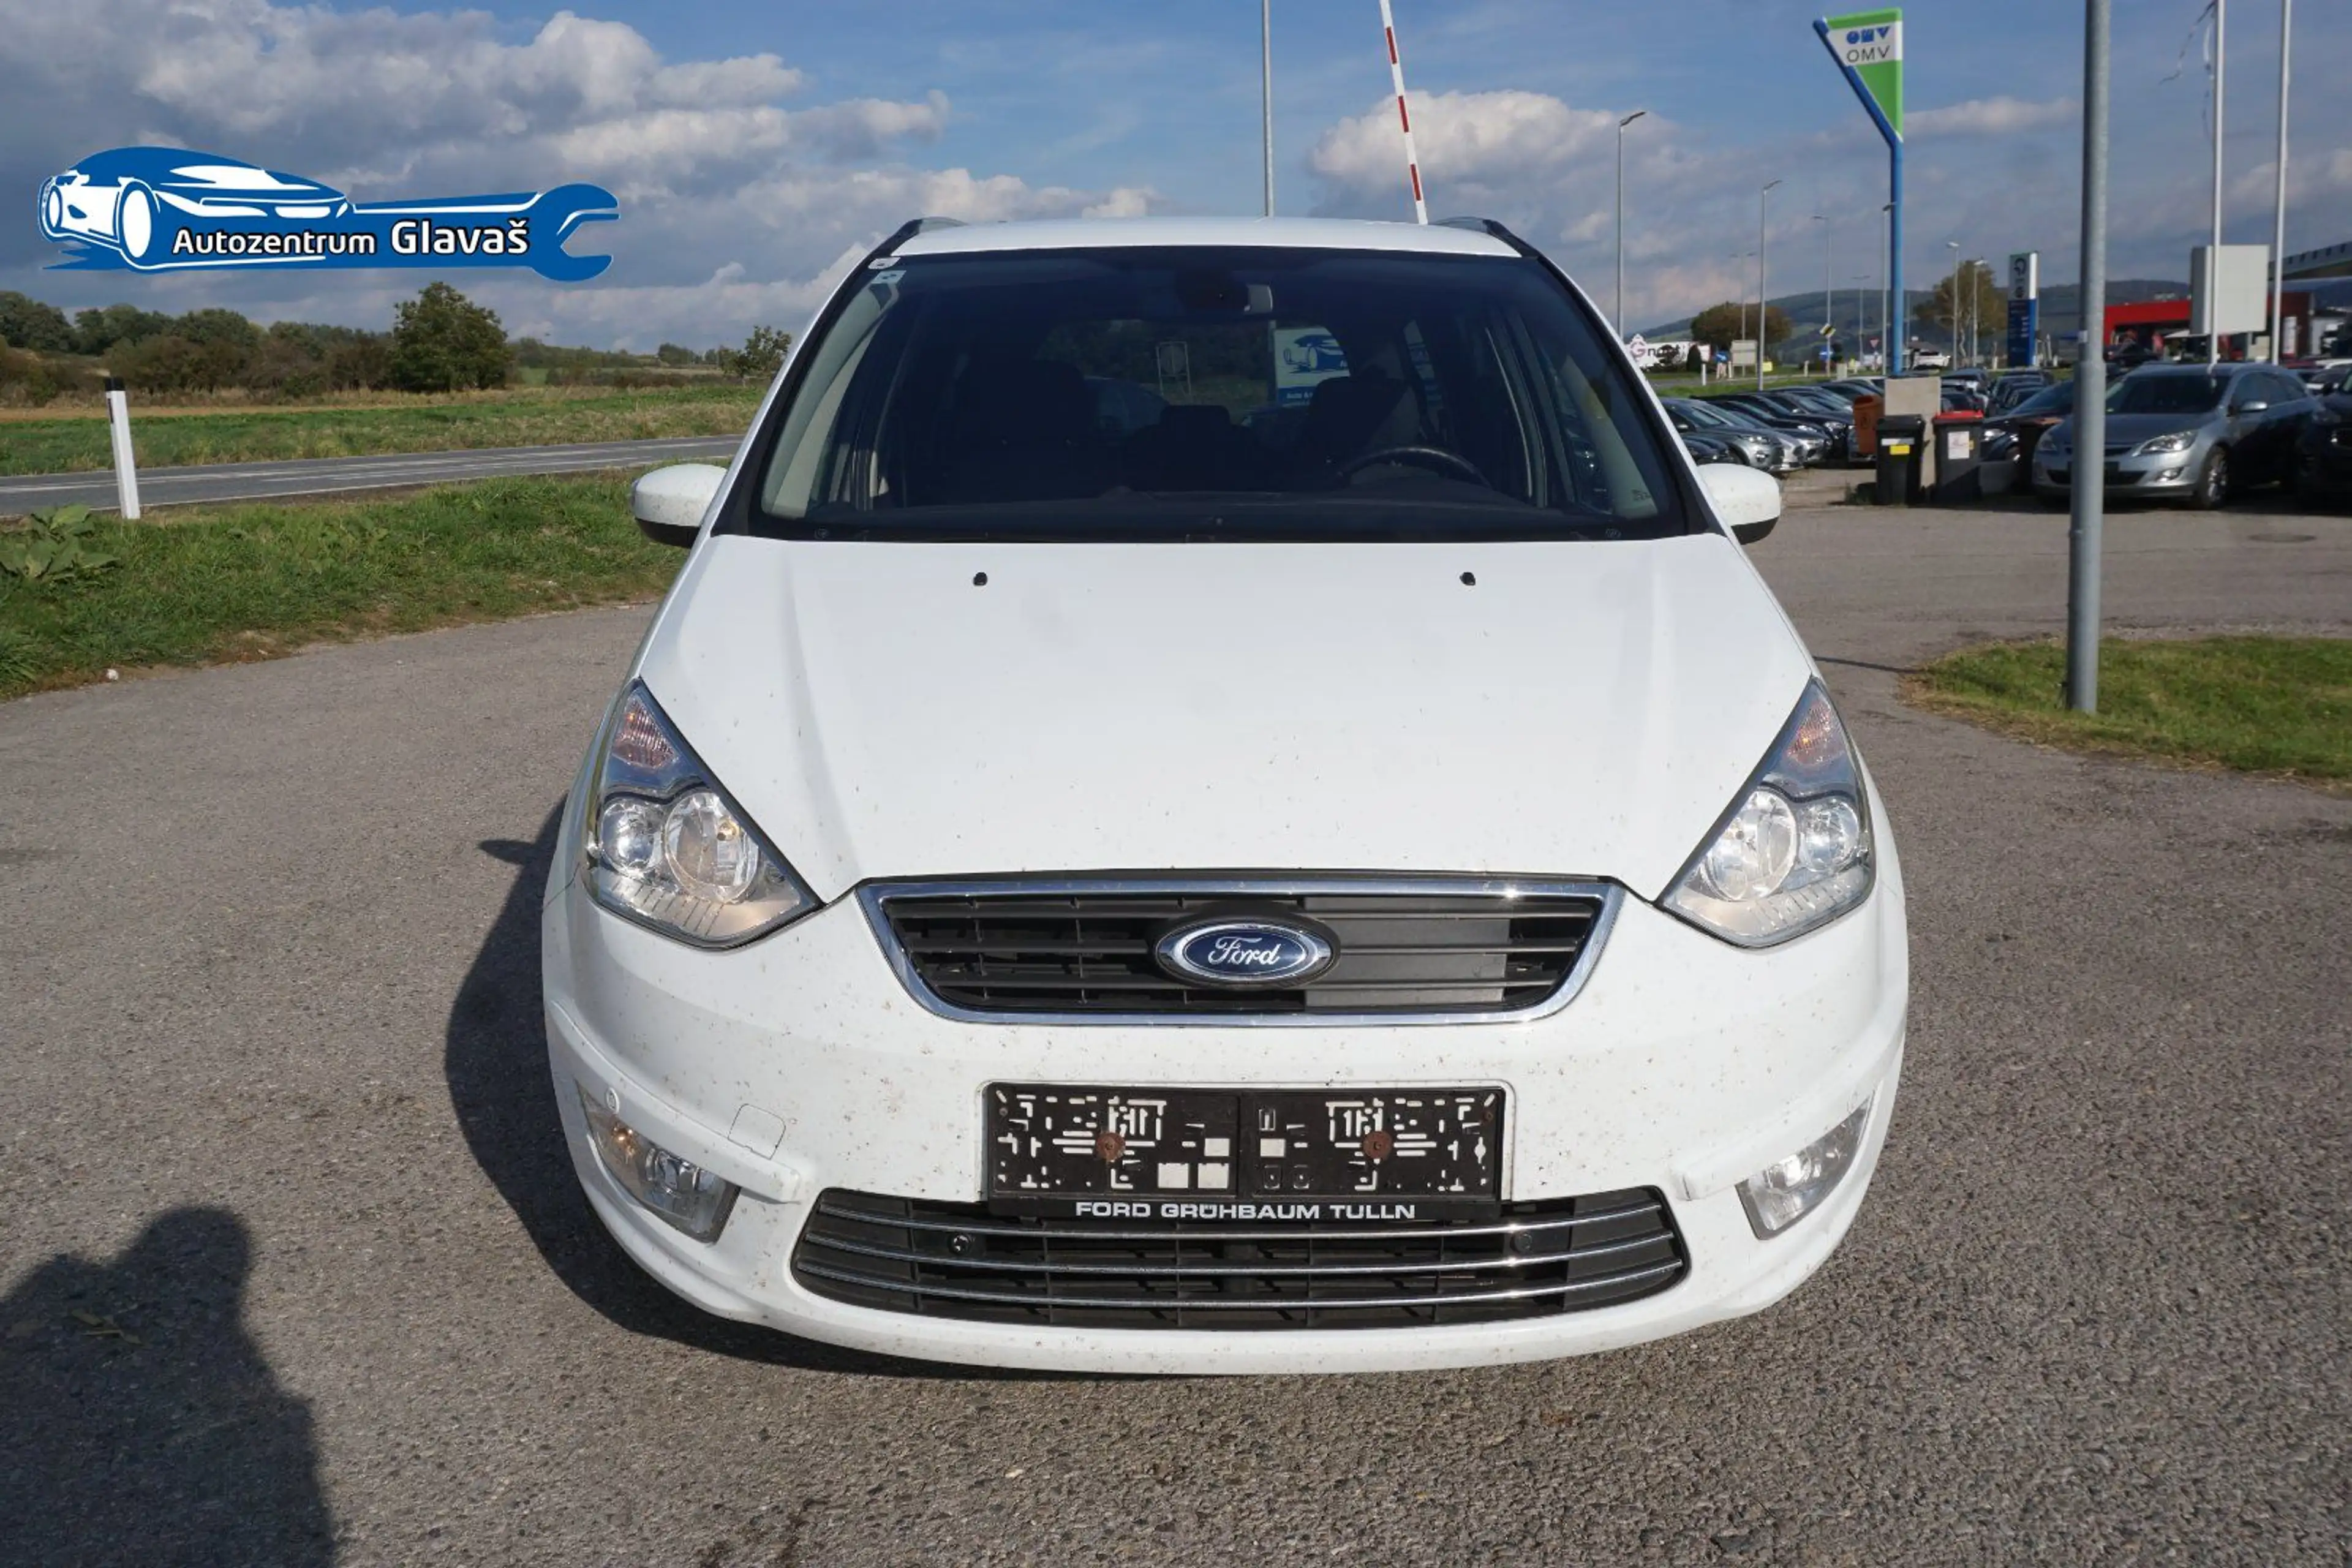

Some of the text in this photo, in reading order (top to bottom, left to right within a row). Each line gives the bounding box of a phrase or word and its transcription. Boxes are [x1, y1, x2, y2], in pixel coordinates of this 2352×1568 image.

[1846, 45, 1891, 63] OMV
[1208, 937, 1281, 965] Ford
[1076, 1202, 1415, 1219] FORD GRÜHBAUM TULLN
